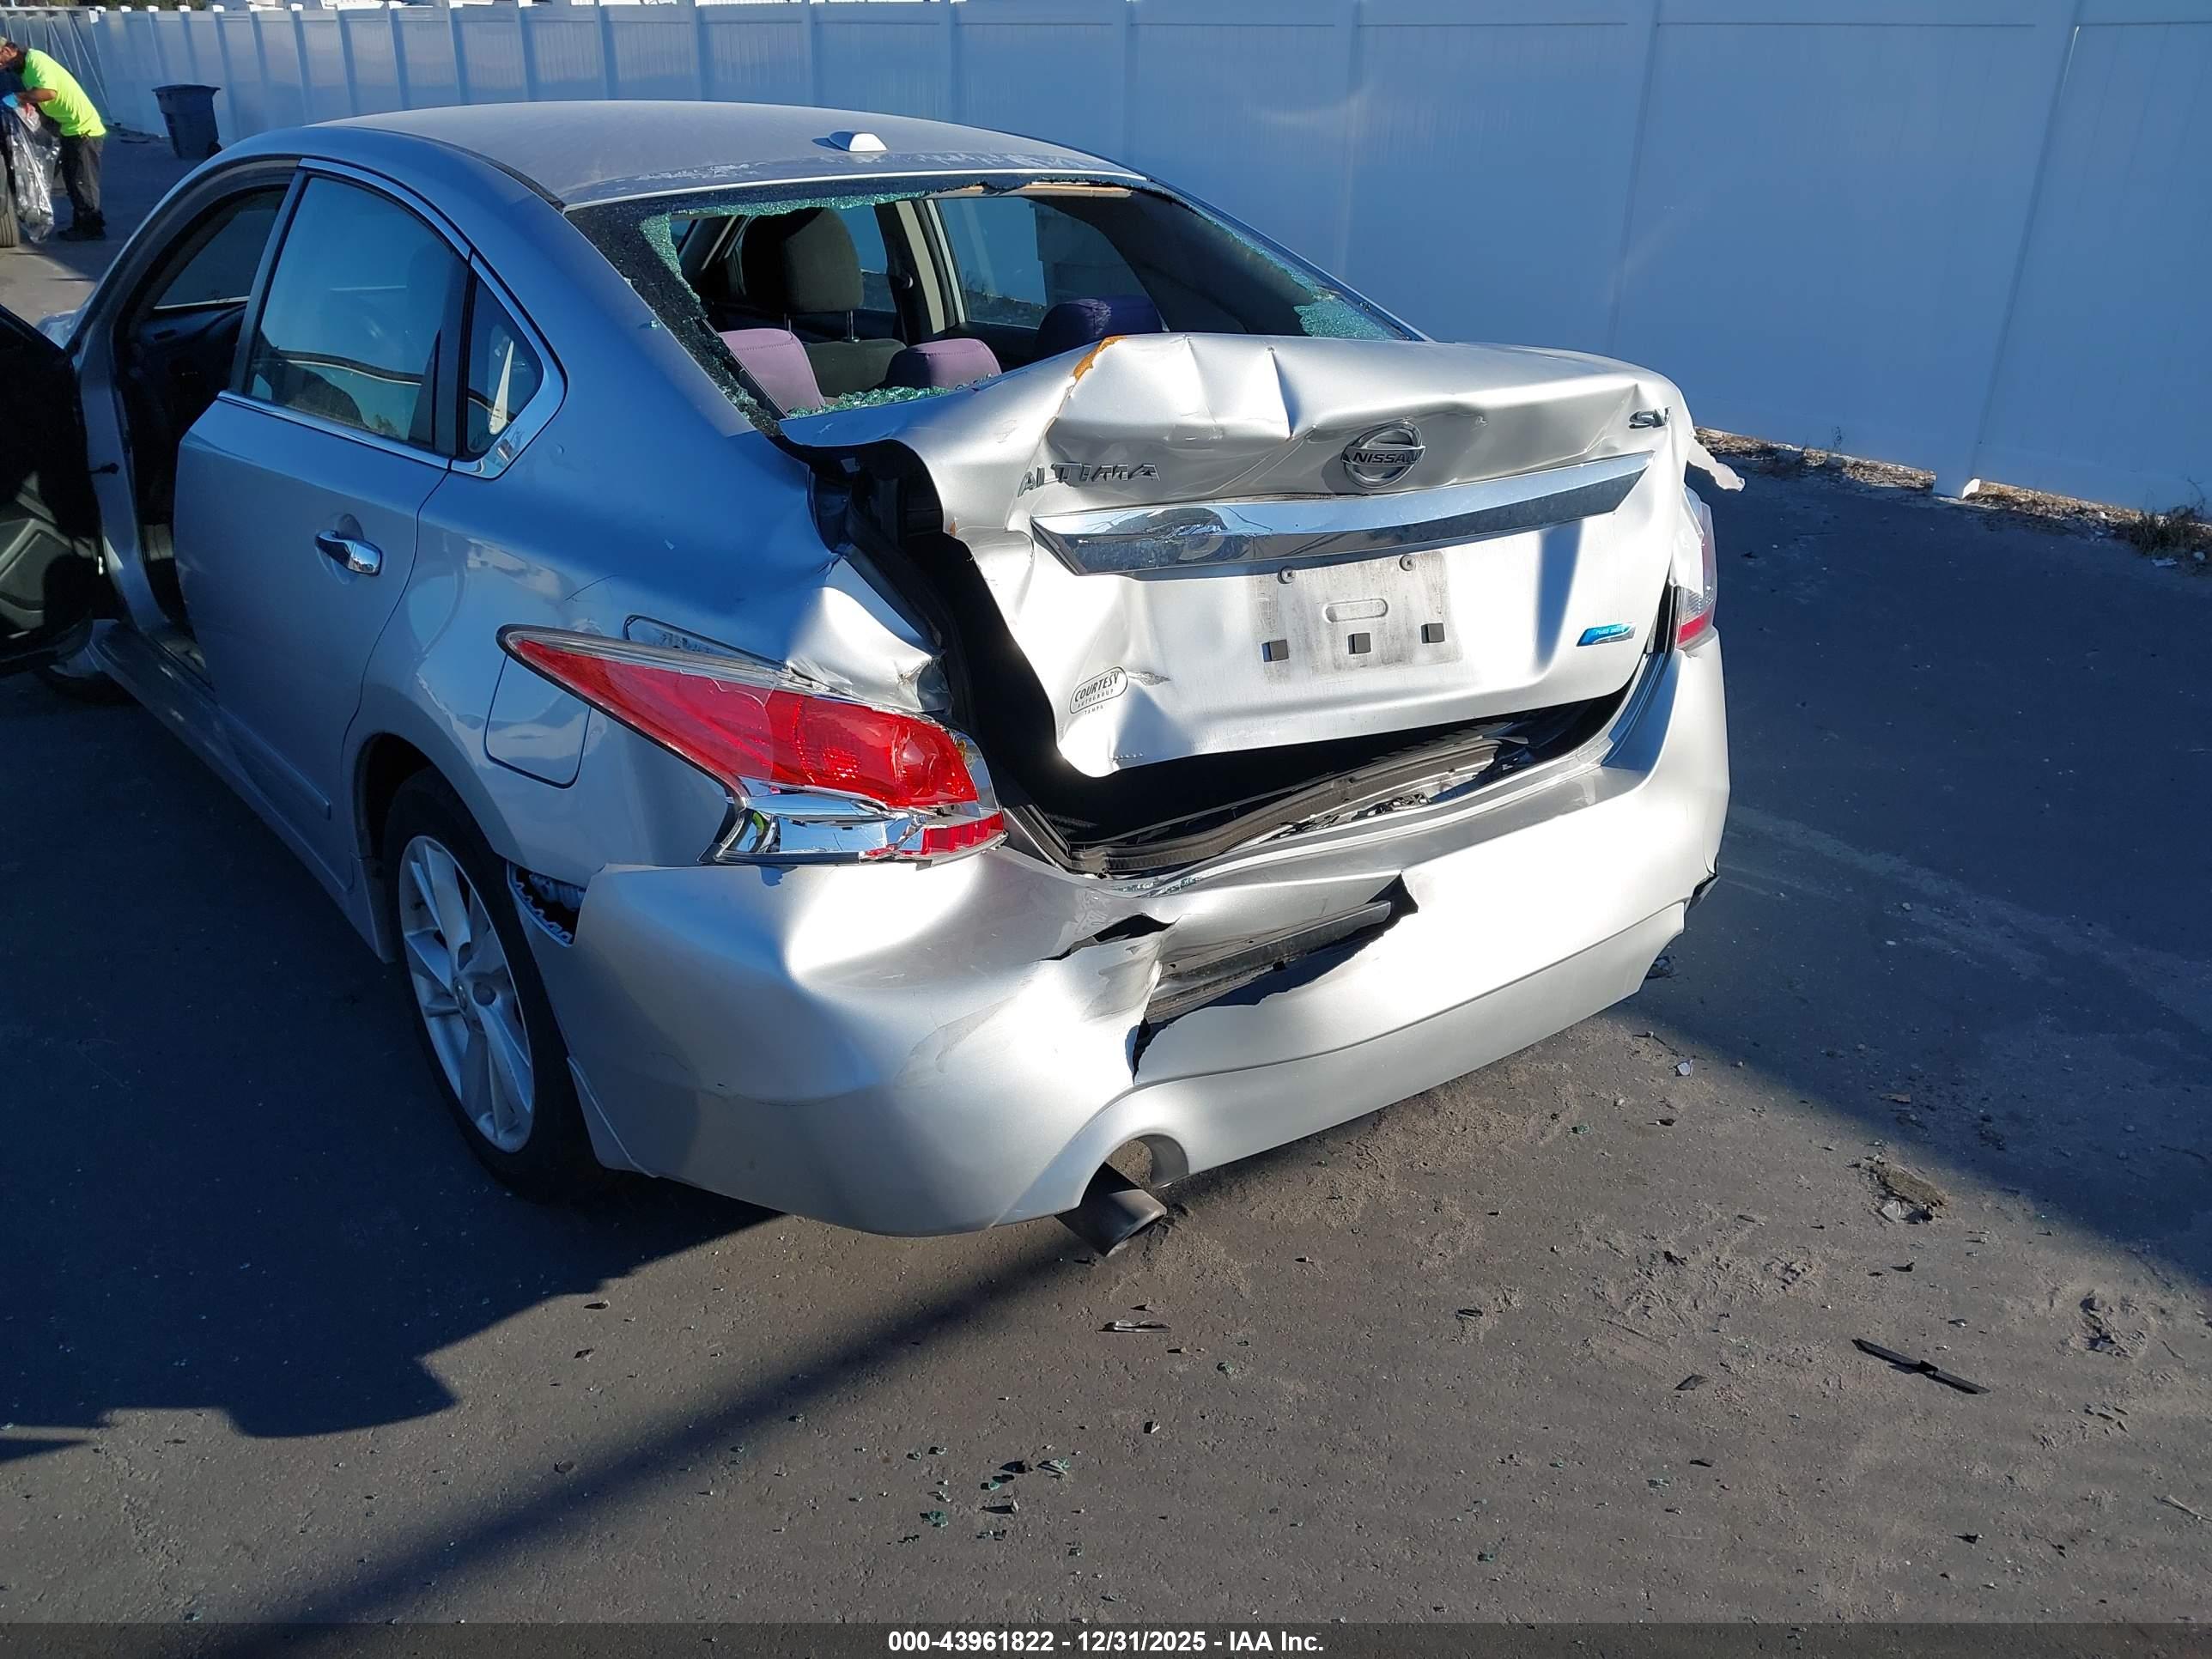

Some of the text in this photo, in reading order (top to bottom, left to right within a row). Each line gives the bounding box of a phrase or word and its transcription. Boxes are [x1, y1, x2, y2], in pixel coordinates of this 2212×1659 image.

[1352, 452, 1419, 464] NISSAN
[1017, 462, 1161, 498] ALTIMA
[1074, 671, 1122, 702] COURTESY
